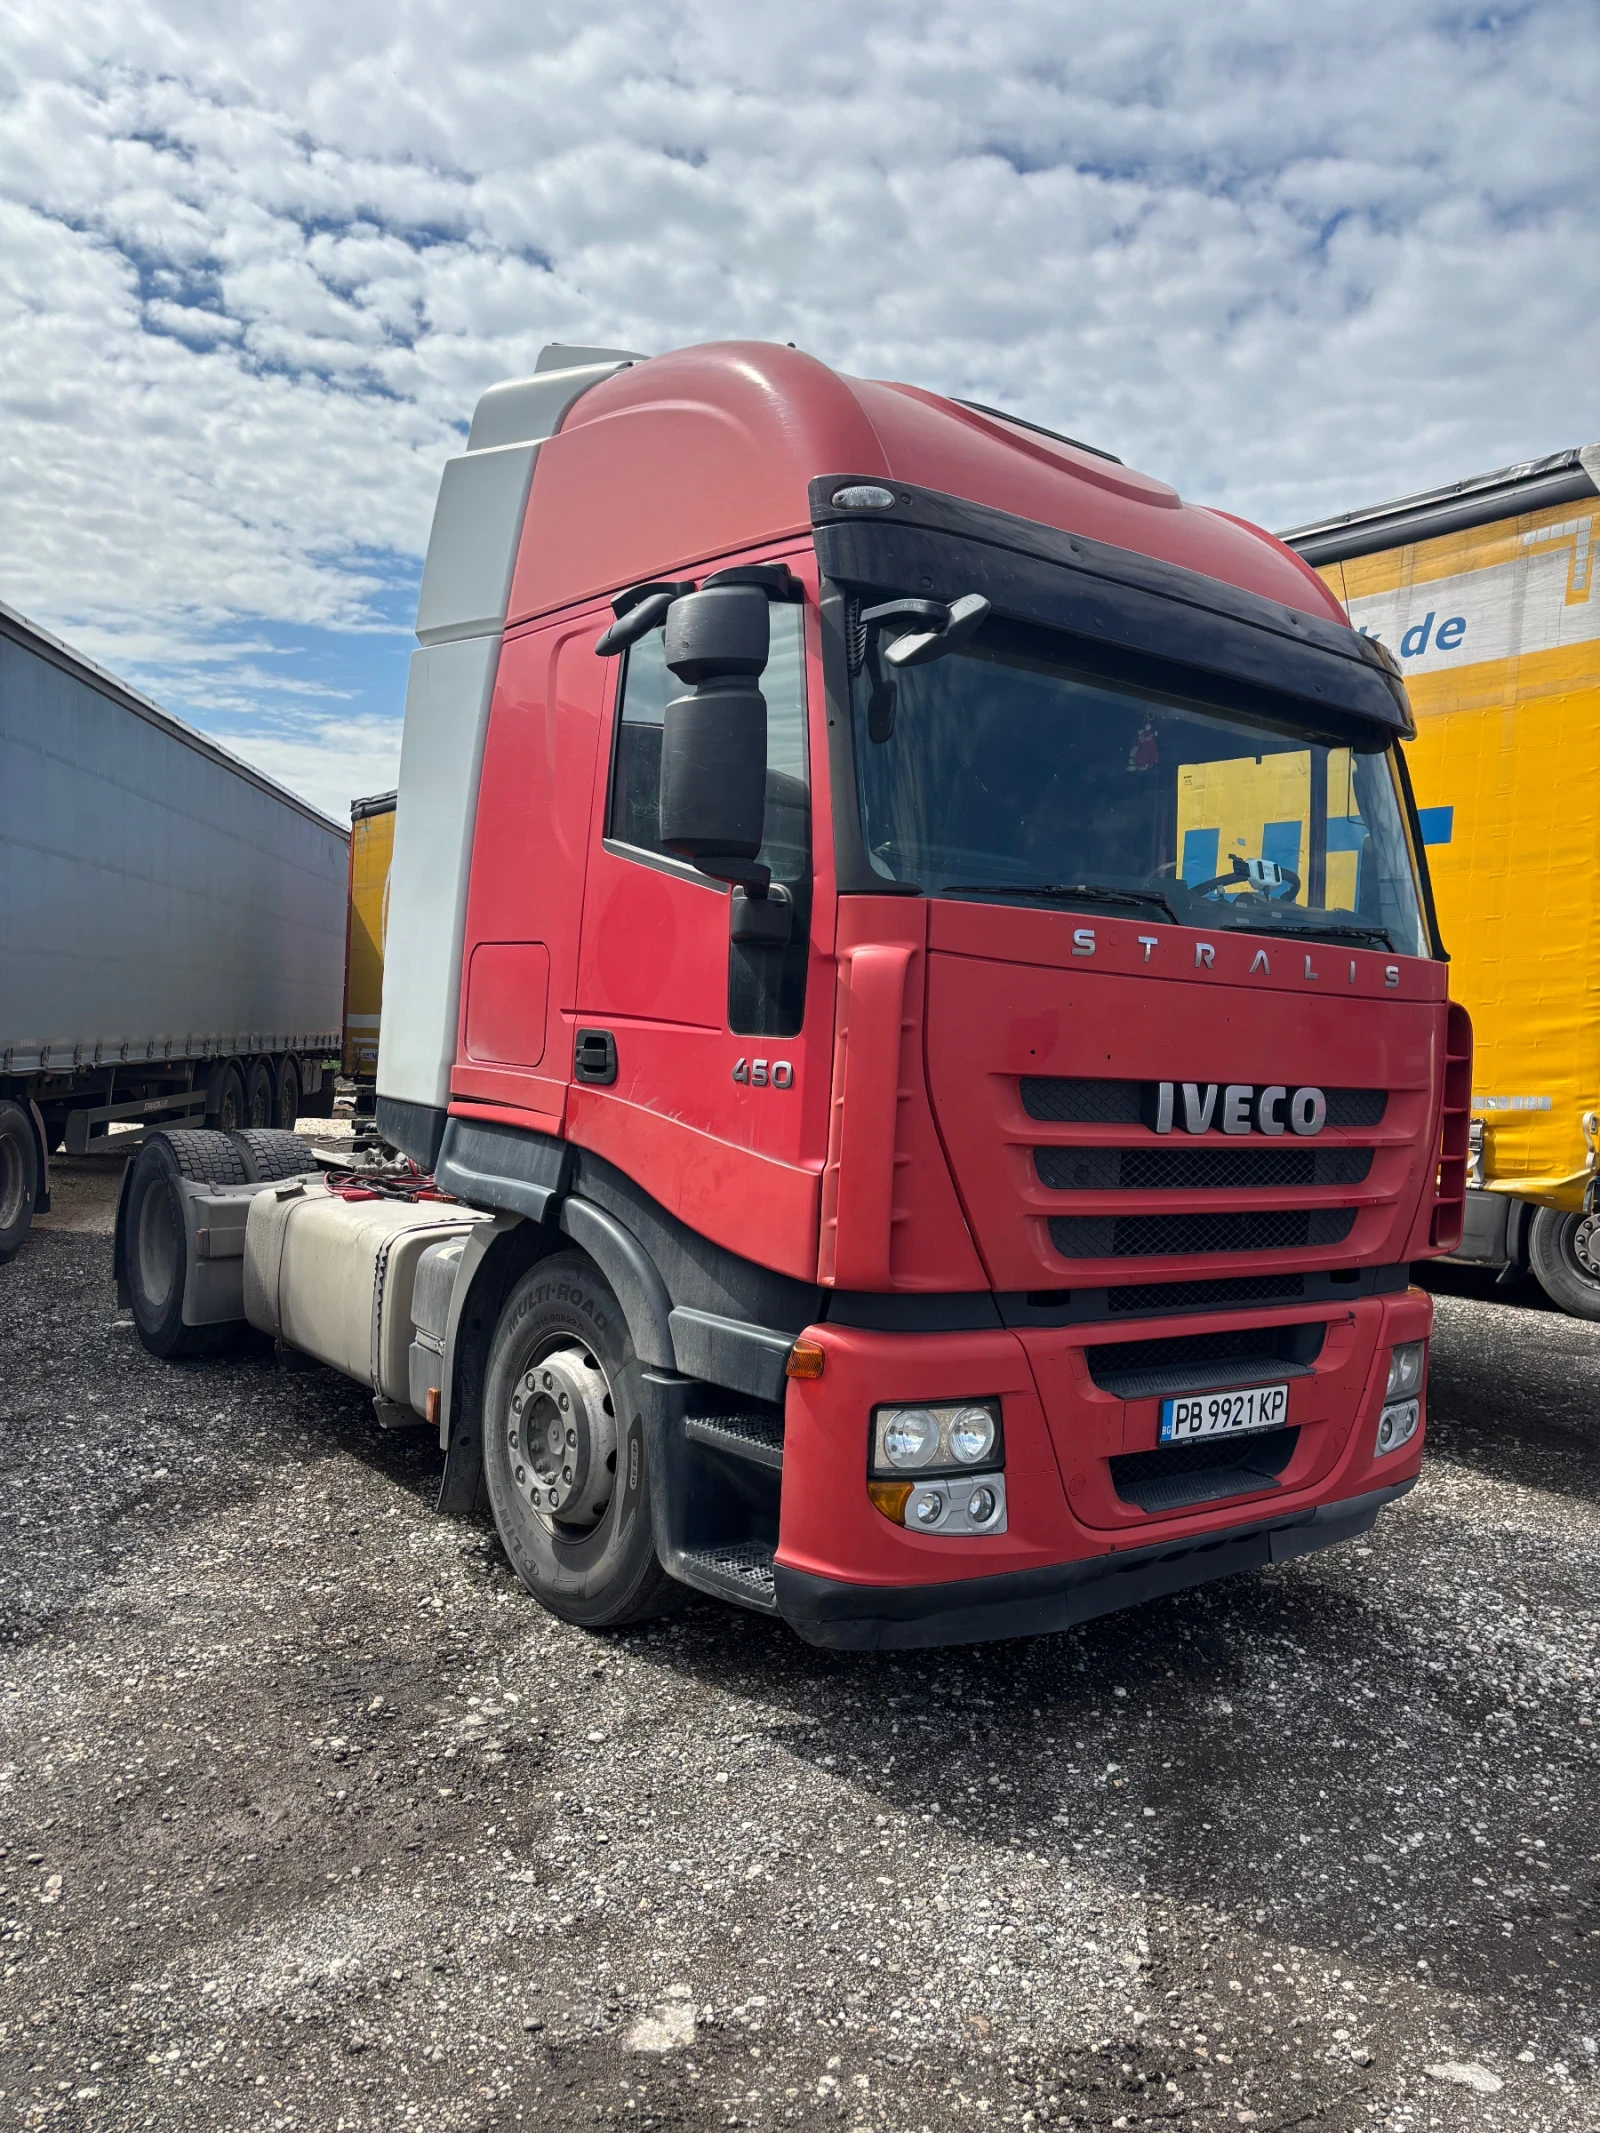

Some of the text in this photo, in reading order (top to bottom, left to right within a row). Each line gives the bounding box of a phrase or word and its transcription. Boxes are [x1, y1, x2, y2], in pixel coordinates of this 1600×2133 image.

[1071, 929, 1401, 988] STRALIS
[731, 1056, 793, 1089] 450
[1155, 1081, 1327, 1136] IVECO
[1161, 1425, 1172, 1436] BG
[1174, 1401, 1203, 1436] PB
[1208, 1393, 1254, 1430] 9921
[1258, 1390, 1285, 1423] KP
